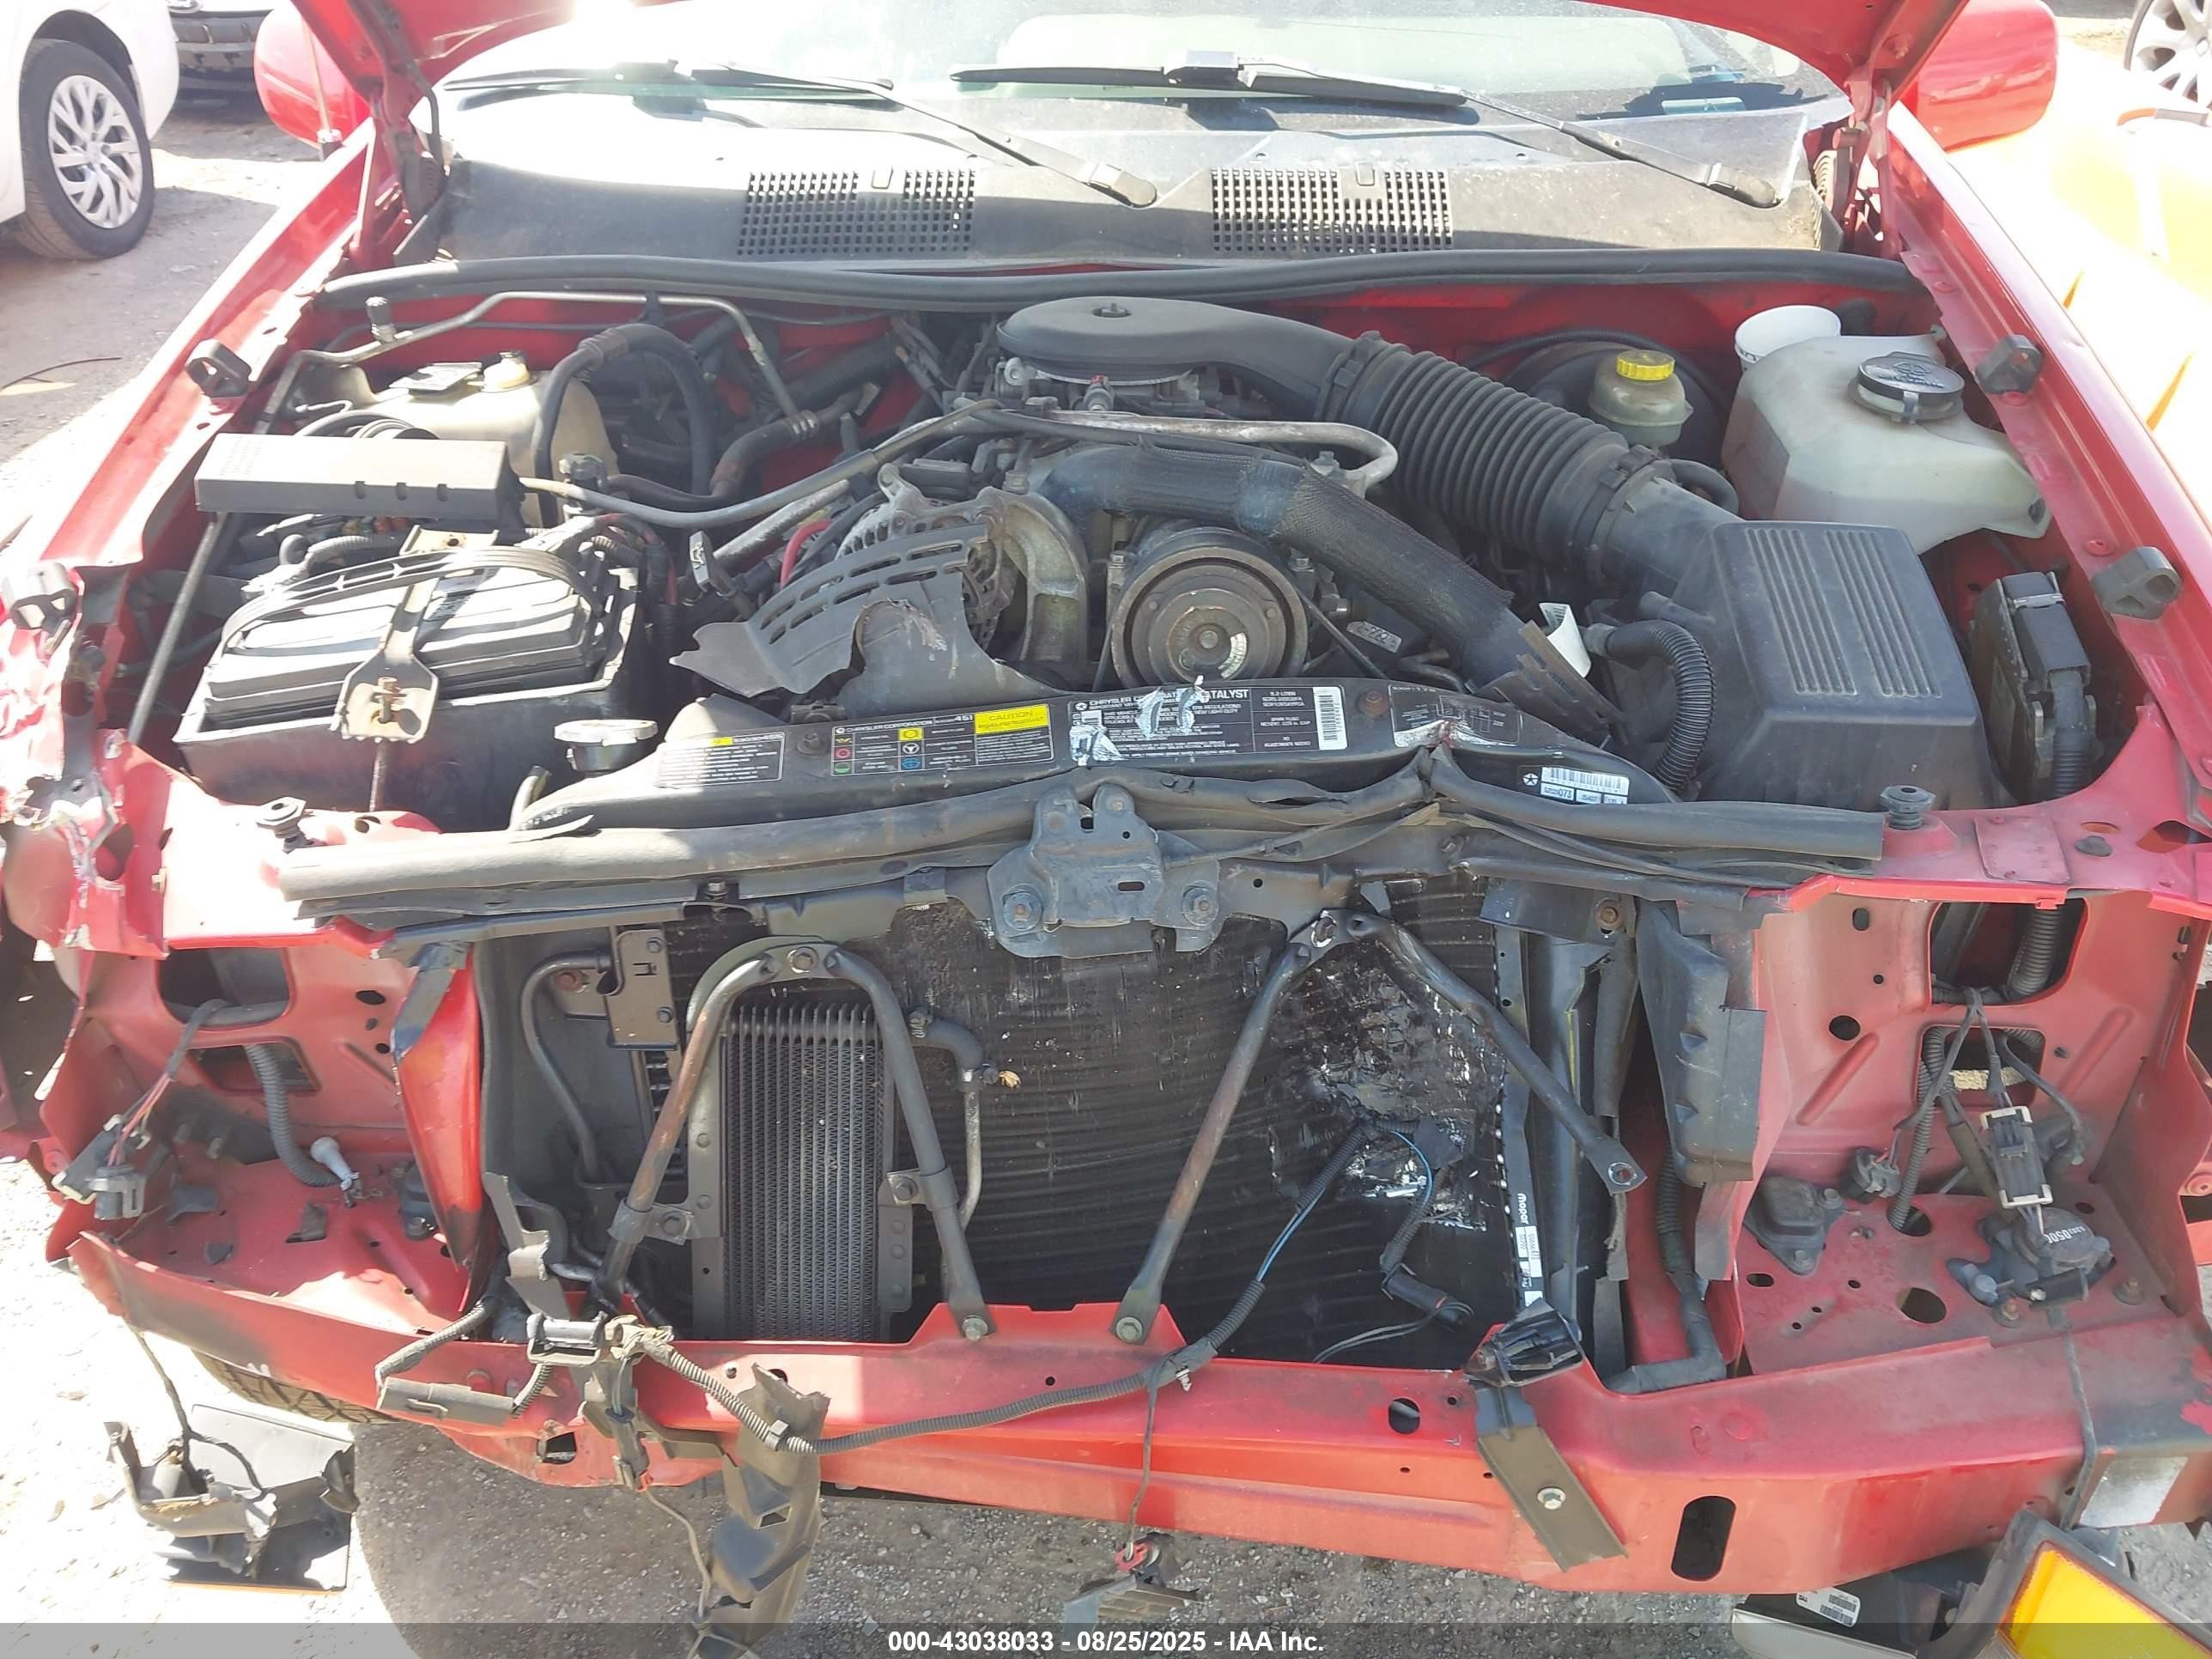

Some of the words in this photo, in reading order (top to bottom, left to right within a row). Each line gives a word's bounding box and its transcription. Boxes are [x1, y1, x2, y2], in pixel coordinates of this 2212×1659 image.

[1206, 690, 1249, 699] ATALYST
[1089, 696, 1132, 705] CHRYSLER
[989, 711, 1034, 721] CAUTION
